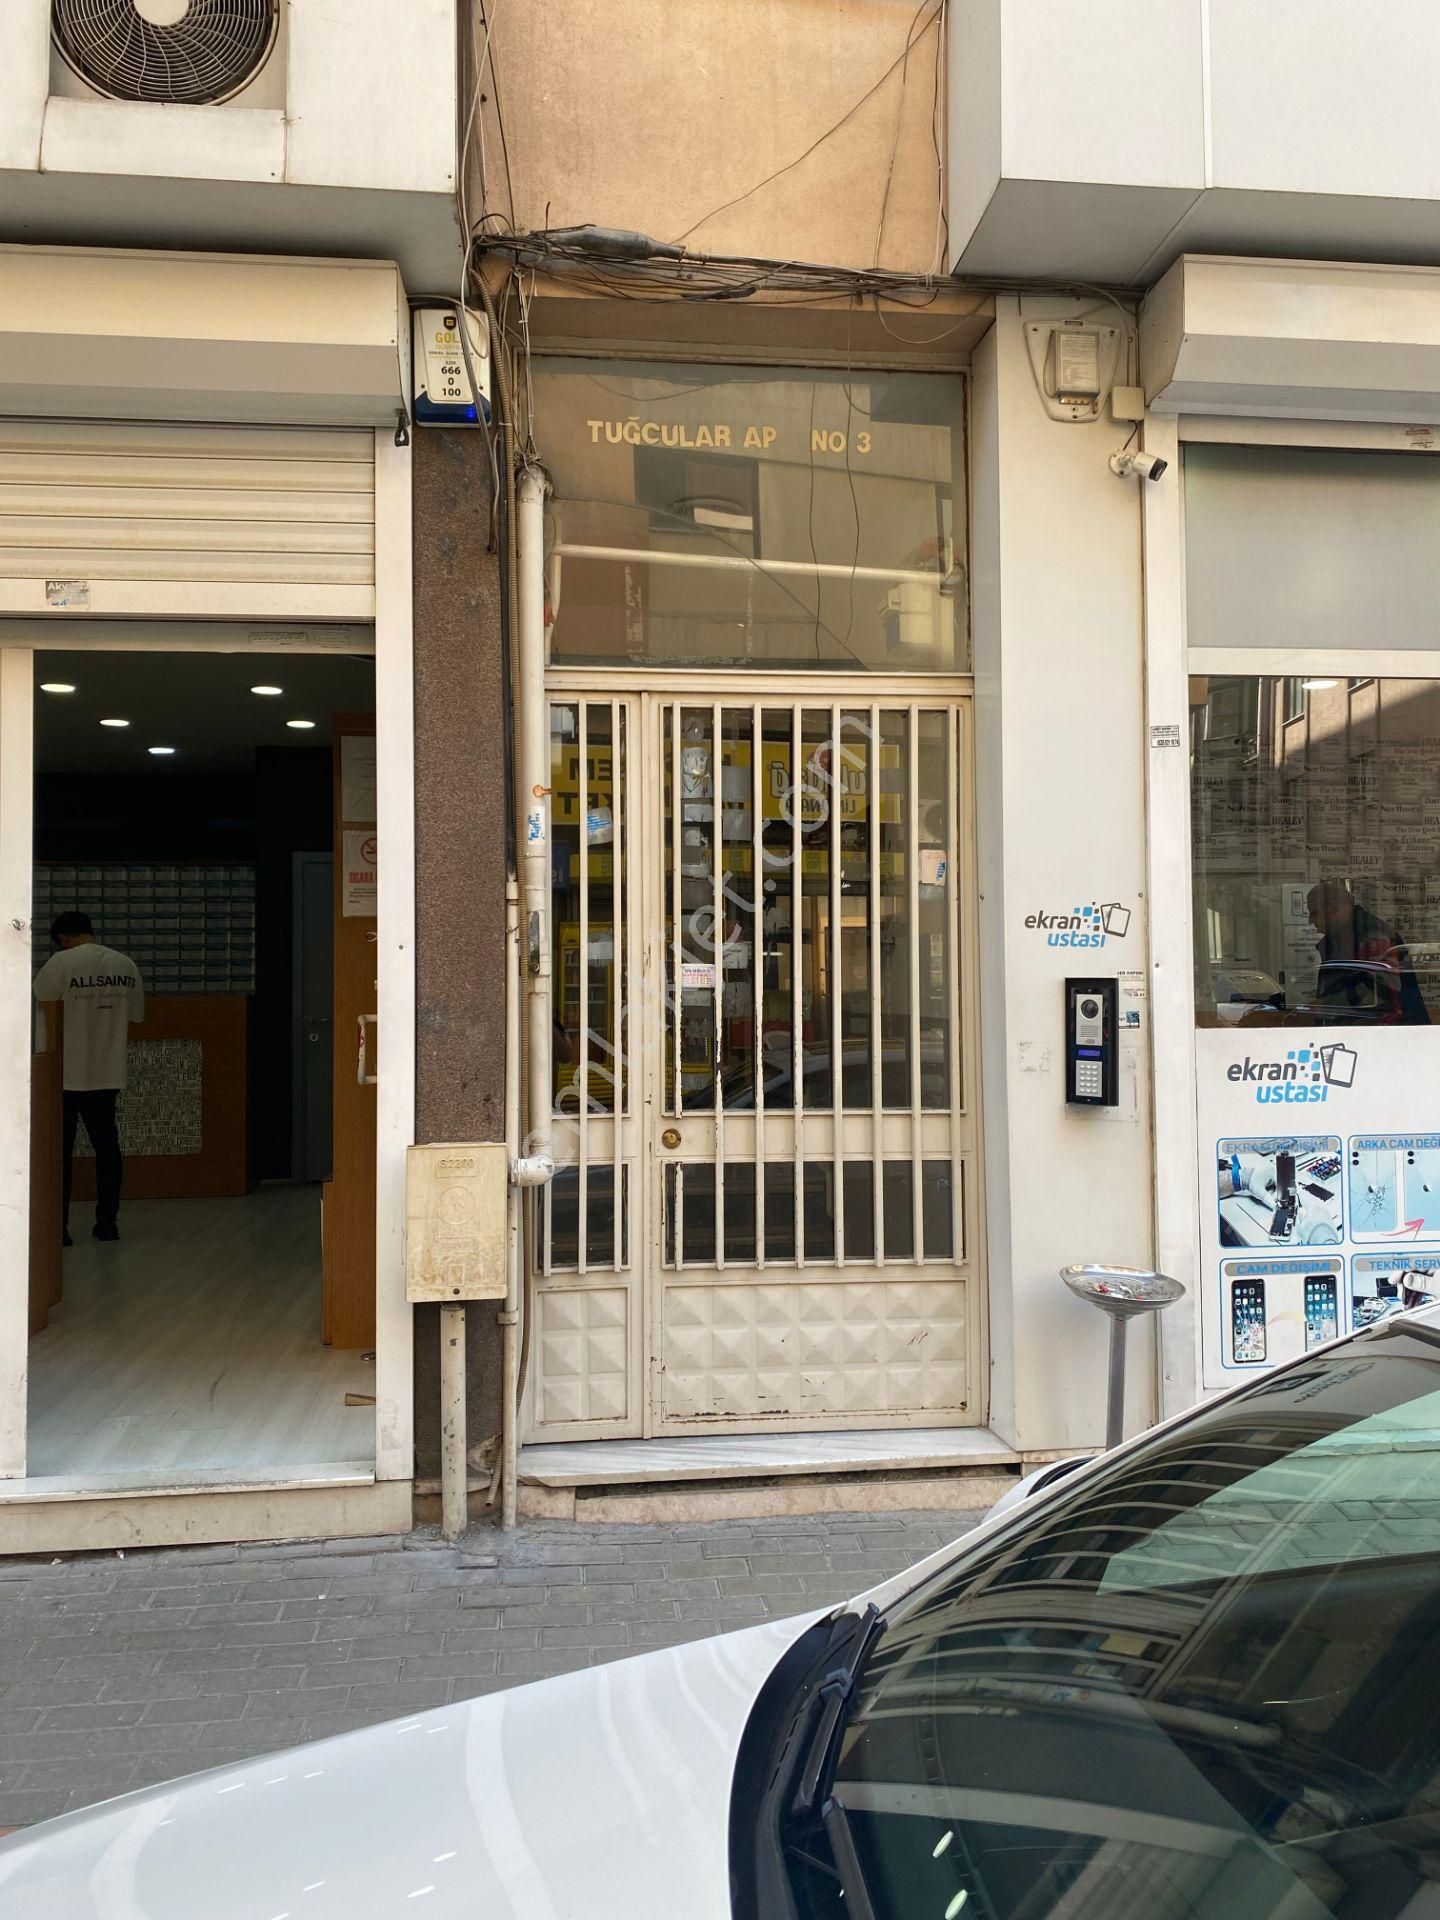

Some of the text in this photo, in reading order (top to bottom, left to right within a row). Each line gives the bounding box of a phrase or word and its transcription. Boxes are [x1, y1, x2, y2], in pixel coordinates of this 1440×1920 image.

[435, 331, 461, 344] GOL
[441, 366, 461, 375] 666
[448, 377, 455, 386] 0
[442, 388, 461, 397] 100
[587, 416, 871, 453] TUĞCULAR AP NO 3
[1024, 910, 1081, 930] ekran
[1047, 930, 1106, 948] ustası
[1227, 1056, 1298, 1081] ekran
[1256, 1081, 1329, 1103] ustası
[1358, 1140, 1387, 1150] ARKA
[1389, 1139, 1414, 1149] CAM
[1236, 1263, 1268, 1276] CAM
